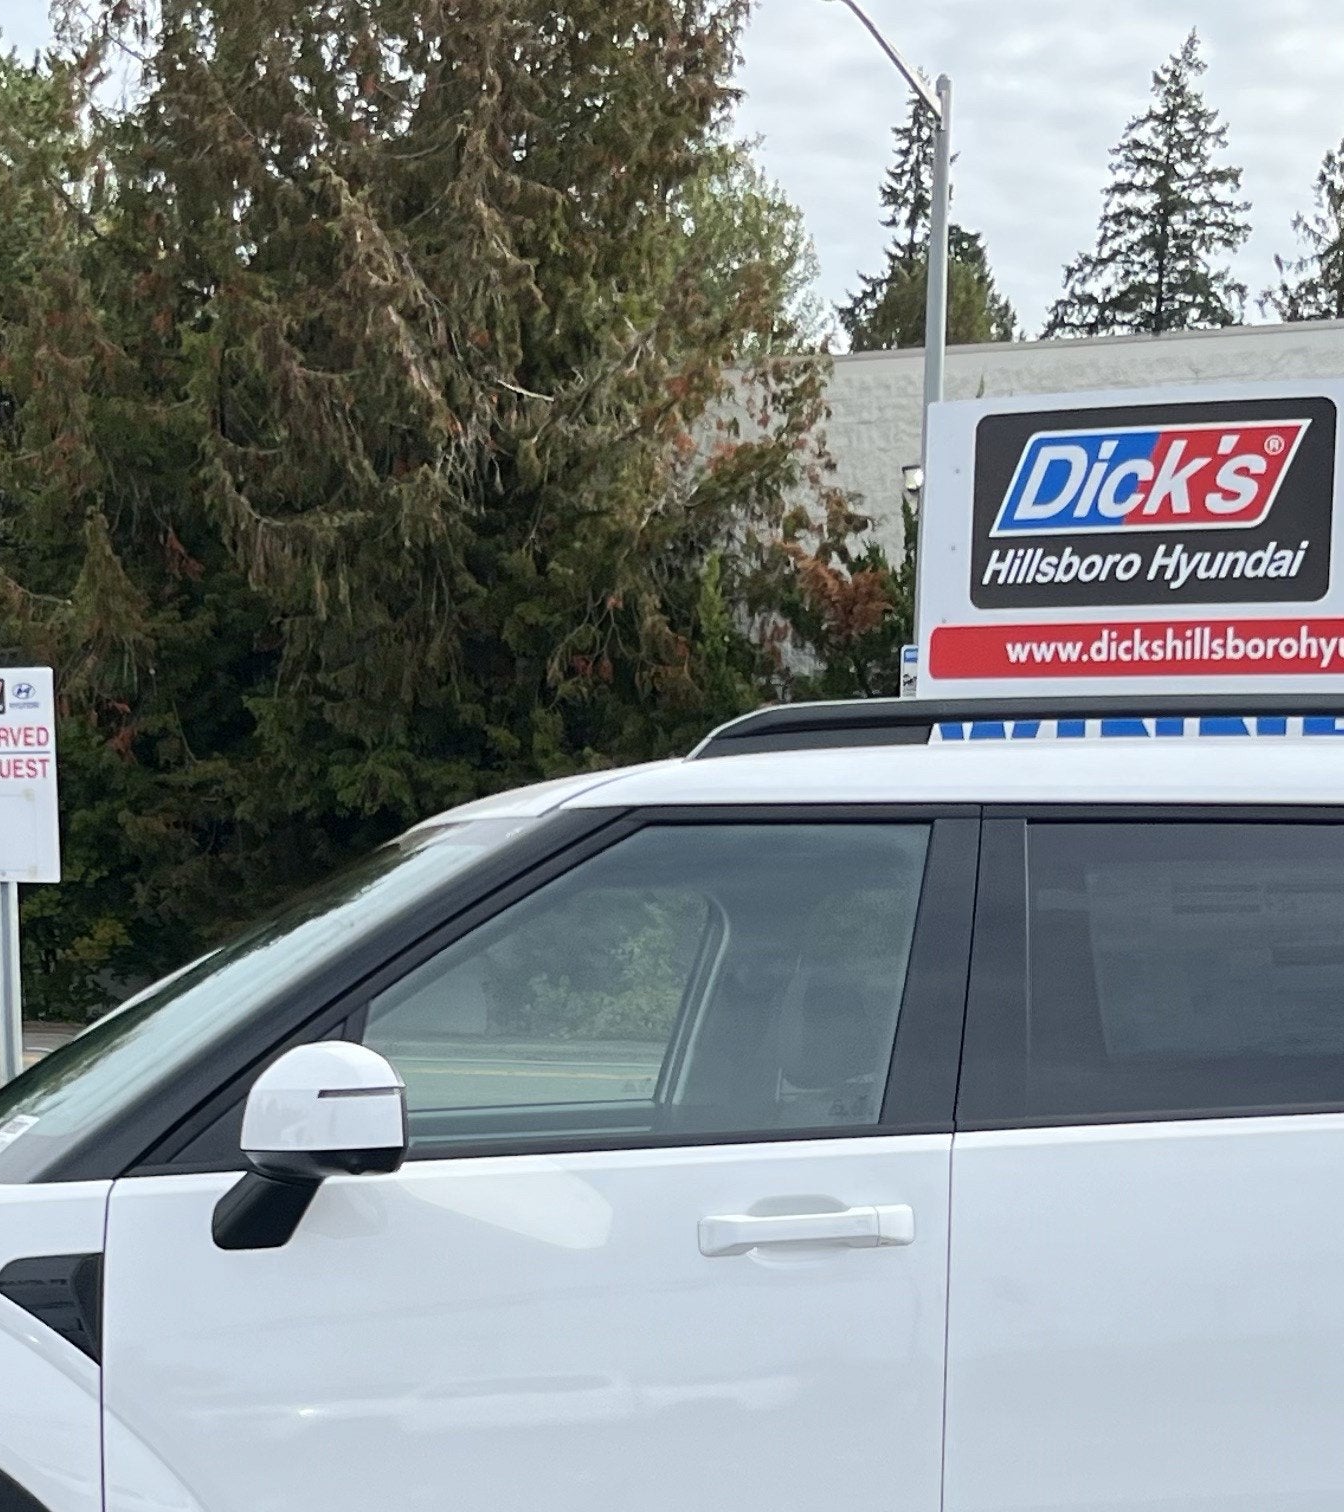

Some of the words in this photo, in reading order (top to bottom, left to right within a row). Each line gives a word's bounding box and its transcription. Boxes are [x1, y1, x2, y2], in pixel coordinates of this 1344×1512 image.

[1012, 434, 1268, 521] Dick's
[981, 547, 1141, 586] Hillsboro
[1146, 540, 1310, 590] Hyundai
